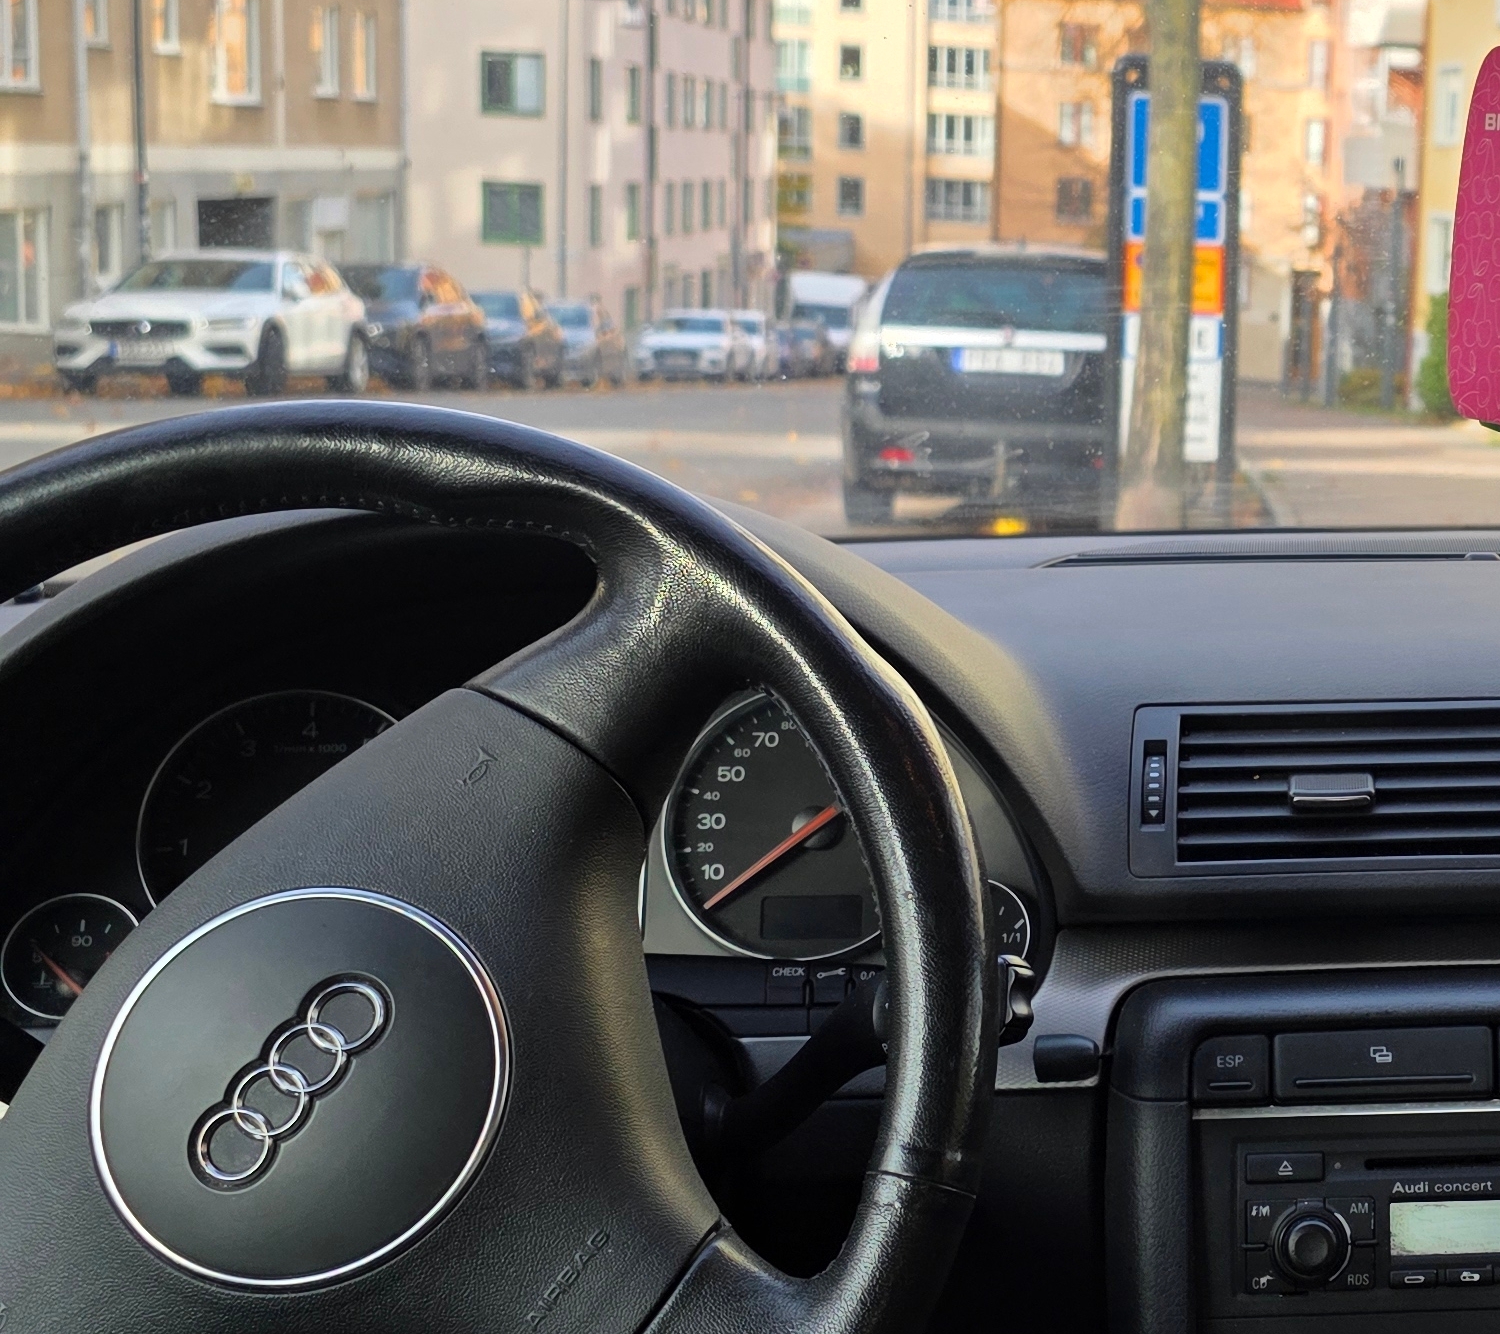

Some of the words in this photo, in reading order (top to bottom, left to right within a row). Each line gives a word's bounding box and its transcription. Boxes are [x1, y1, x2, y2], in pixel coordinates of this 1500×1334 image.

[752, 731, 780, 748] 70
[733, 748, 751, 758] 60
[717, 765, 746, 782] 50
[703, 791, 720, 801] 40
[696, 813, 726, 830] 30
[696, 842, 714, 852] 20
[701, 863, 725, 880] 10
[71, 935, 93, 947] 90
[772, 967, 805, 977] CHECK
[1216, 1054, 1244, 1068] ESP
[1392, 1181, 1429, 1194] Audi
[1434, 1181, 1493, 1193] concert
[1350, 1202, 1369, 1214] AM
[1347, 1273, 1370, 1286] RDS
